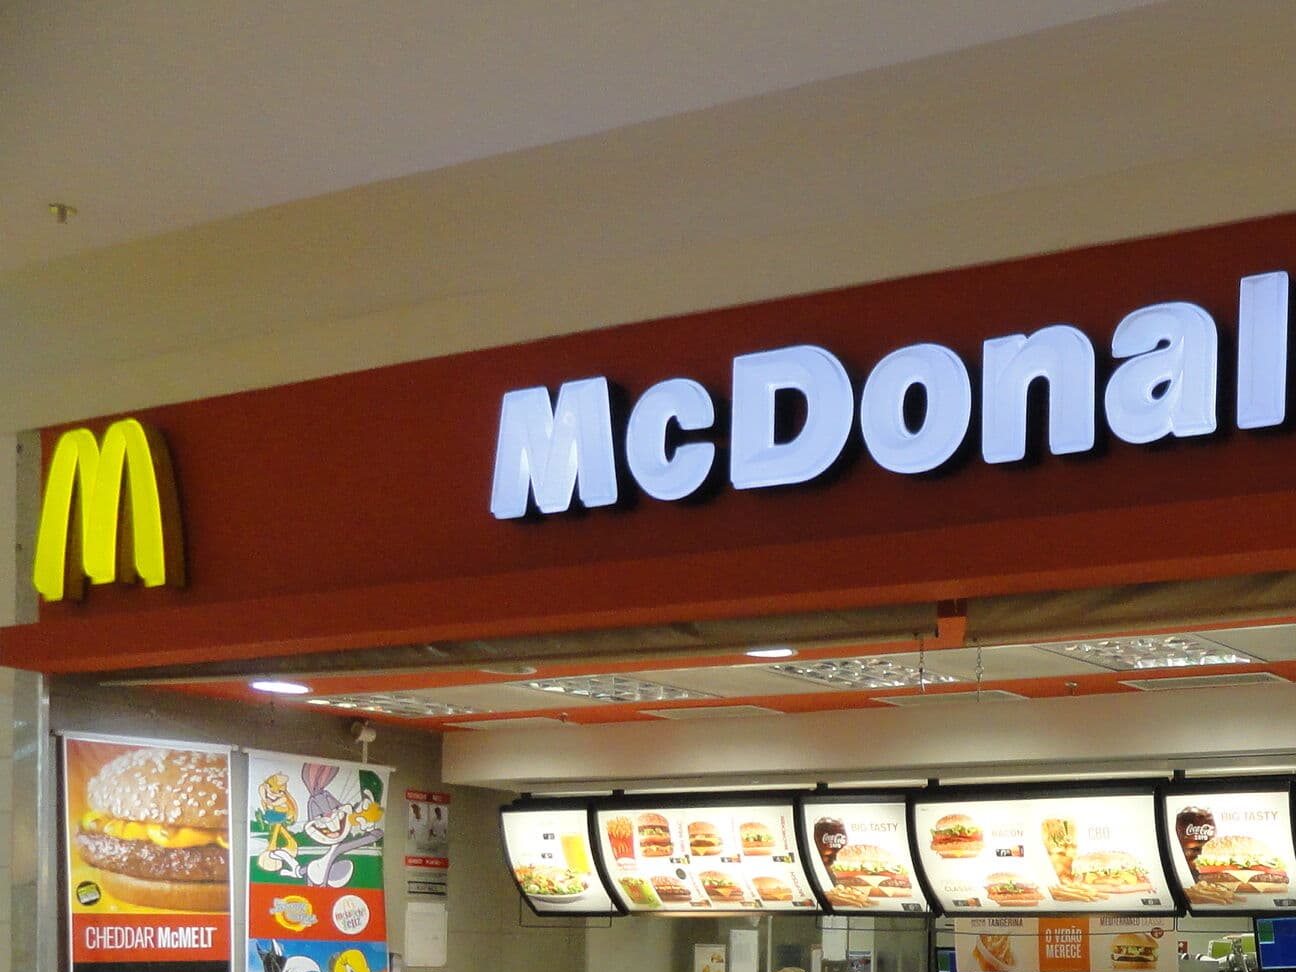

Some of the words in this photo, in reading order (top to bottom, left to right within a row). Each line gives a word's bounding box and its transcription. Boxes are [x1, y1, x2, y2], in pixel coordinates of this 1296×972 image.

[85, 926, 155, 950] CHEDDAR
[157, 926, 215, 949] McMELT
[1045, 928, 1052, 943] O
[1055, 925, 1082, 943] VERÃO
[1045, 944, 1082, 959] MERECE
